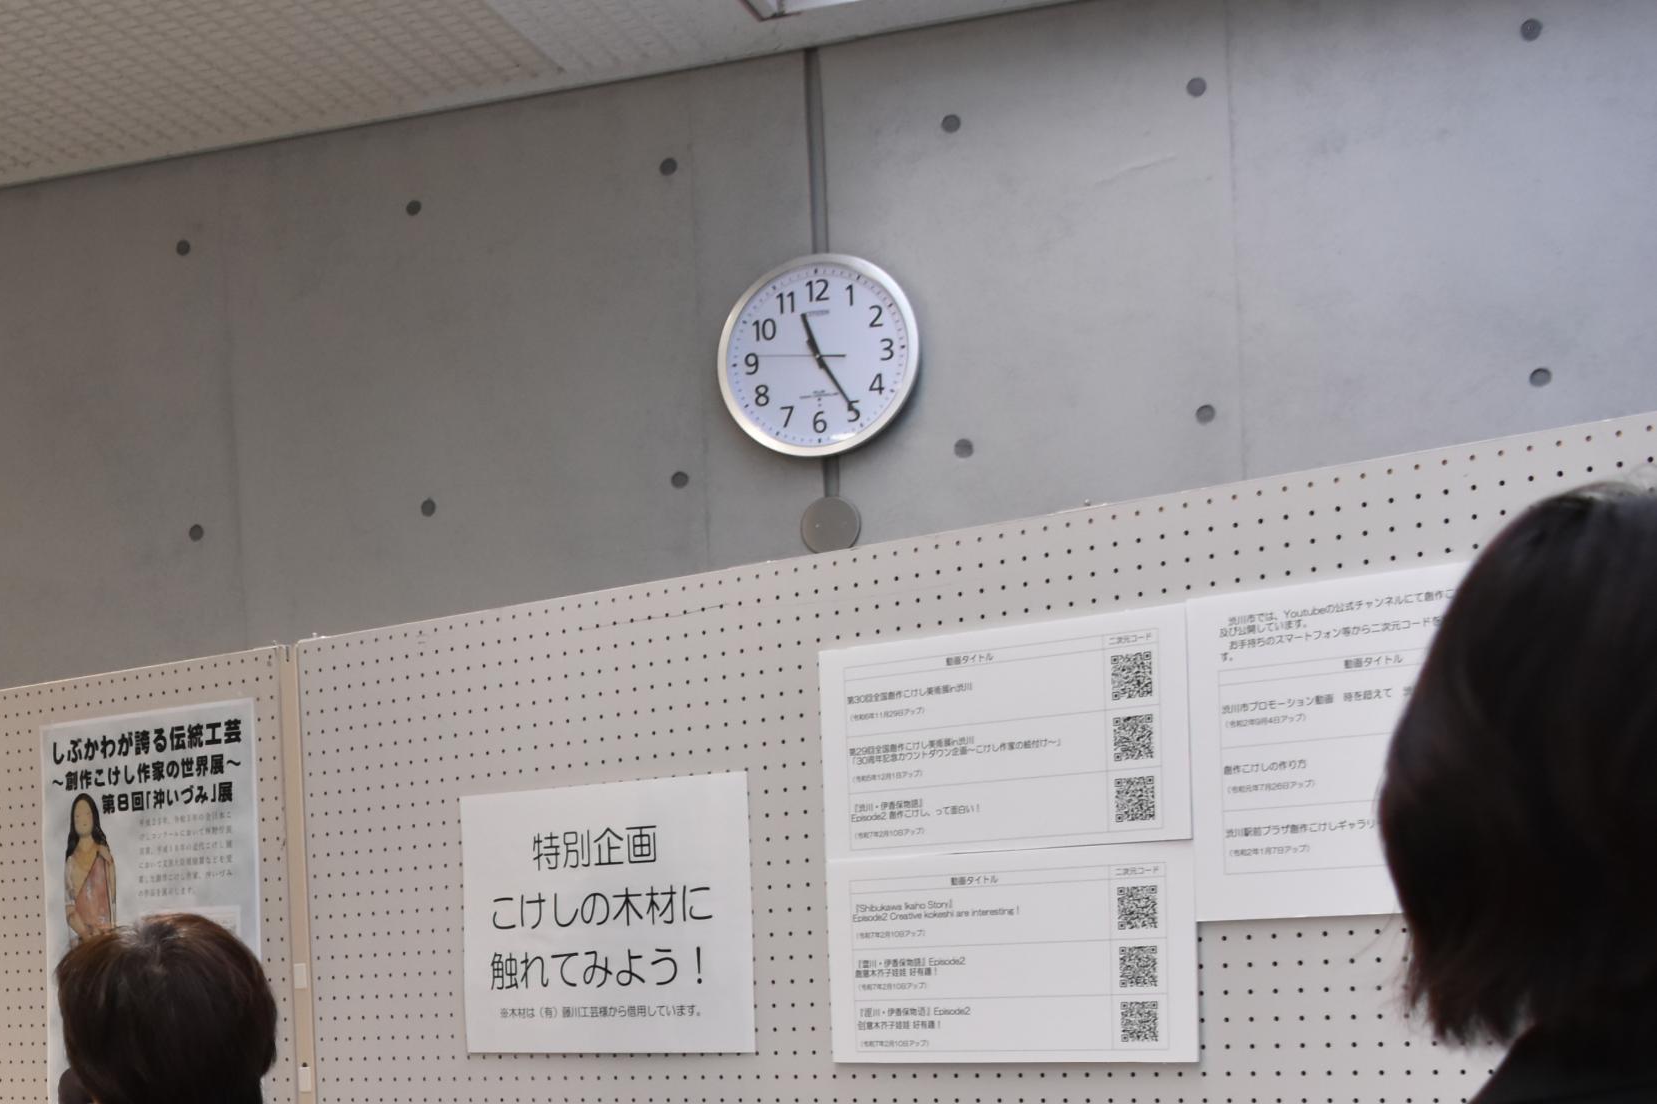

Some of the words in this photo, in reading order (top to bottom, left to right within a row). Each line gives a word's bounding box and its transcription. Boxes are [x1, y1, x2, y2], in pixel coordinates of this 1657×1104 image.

[805, 278, 830, 302] 12
[845, 284, 854, 306] 1
[776, 291, 795, 314] 11
[868, 305, 884, 328] 2
[752, 318, 777, 341] 10
[880, 338, 894, 361] 3
[744, 352, 759, 375] 9
[754, 384, 770, 407] 8
[869, 373, 885, 395] 4
[780, 406, 794, 428] 7
[812, 411, 827, 433] 6
[847, 400, 861, 422] 5
[945, 652, 994, 668] 動画タイトル
[1344, 654, 1403, 669] 動画タイトル
[52, 719, 242, 765] しぶかわが誇る伝統工芸
[52, 754, 241, 791] ～創作こけし作家の世界展～
[101, 781, 233, 815] 第8回「沖いづみ」展
[1225, 819, 1380, 838] 渋川駅前プラザ創作こけしギャラリ
[532, 825, 658, 871] 特別企画
[950, 875, 999, 886] 動画タイトル
[492, 884, 713, 930] こけしの木材に
[889, 912, 922, 921] Creative
[923, 910, 955, 919] kokeshi
[490, 946, 704, 990] 触れてみよう！
